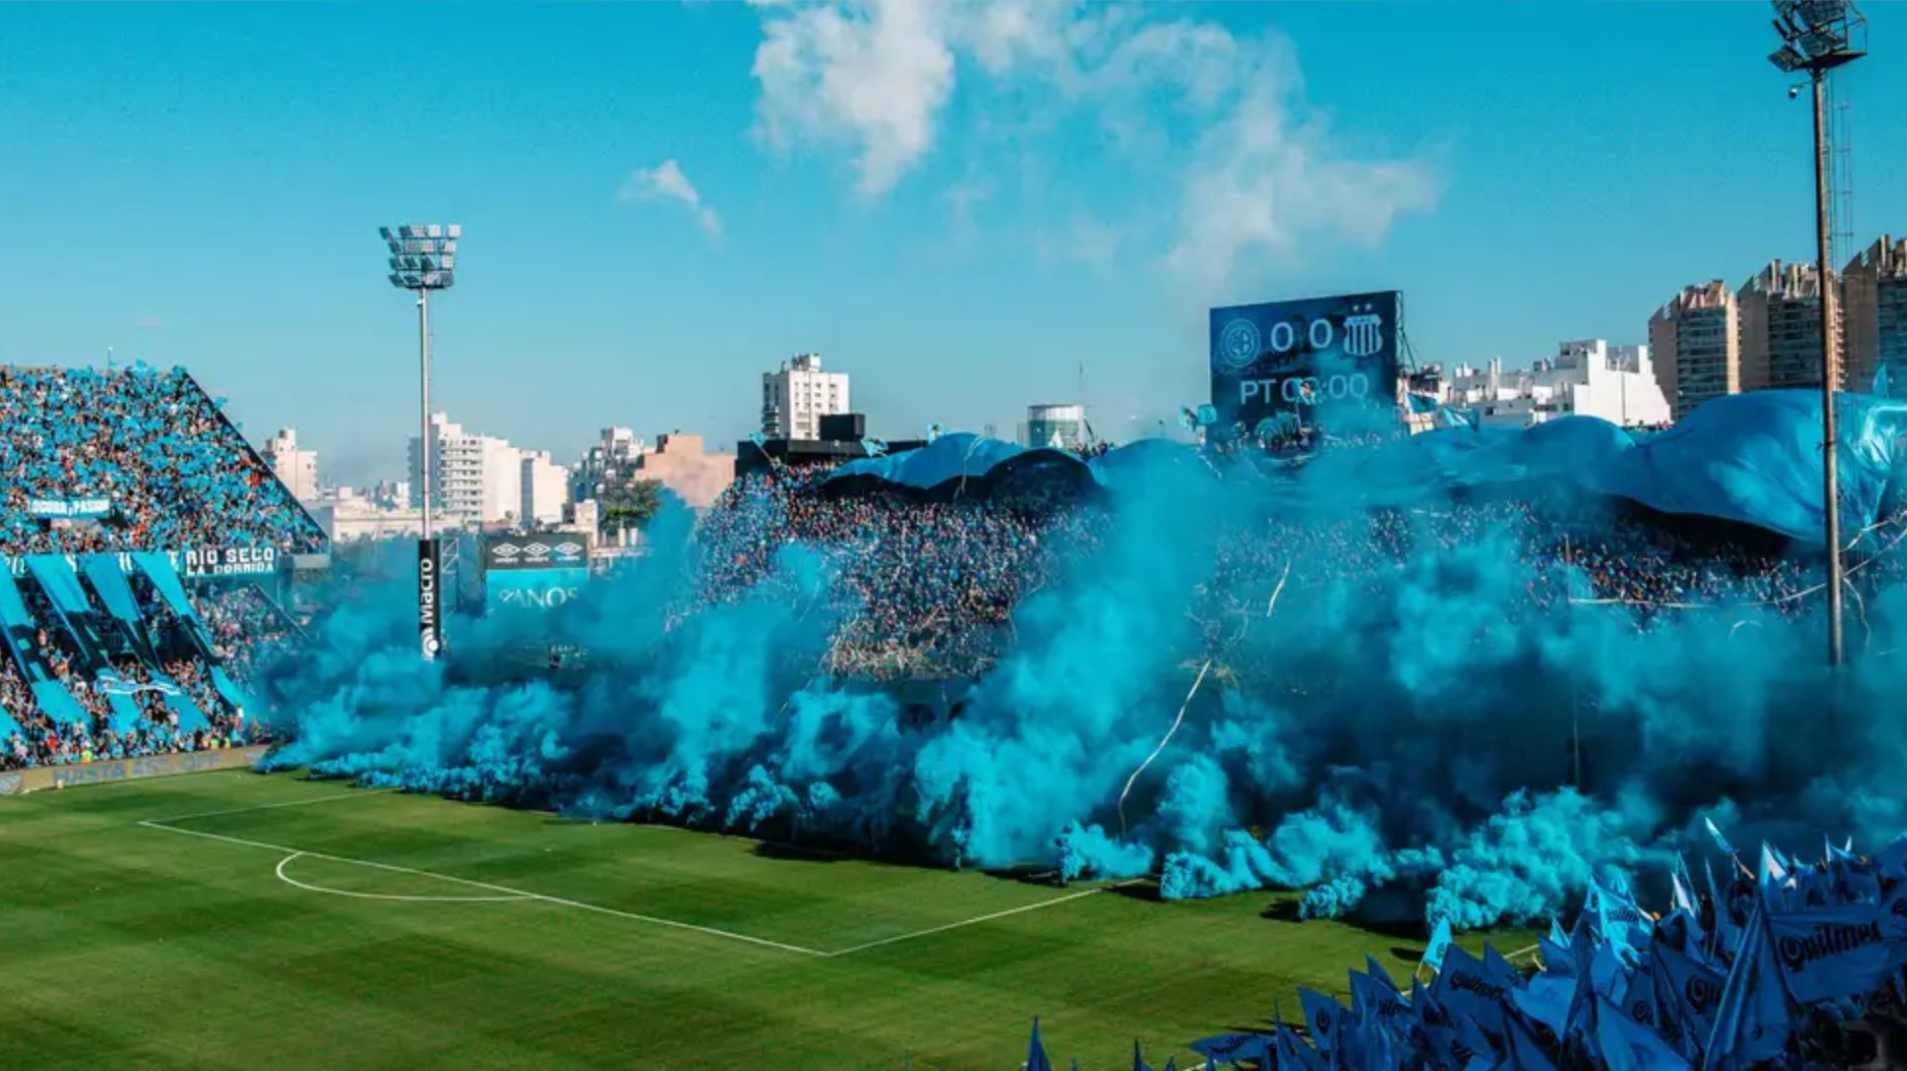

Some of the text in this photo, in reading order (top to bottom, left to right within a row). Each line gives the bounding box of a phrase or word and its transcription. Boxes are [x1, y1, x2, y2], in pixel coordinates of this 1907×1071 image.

[1271, 318, 1333, 352] 0 0
[1240, 379, 1277, 405] PT
